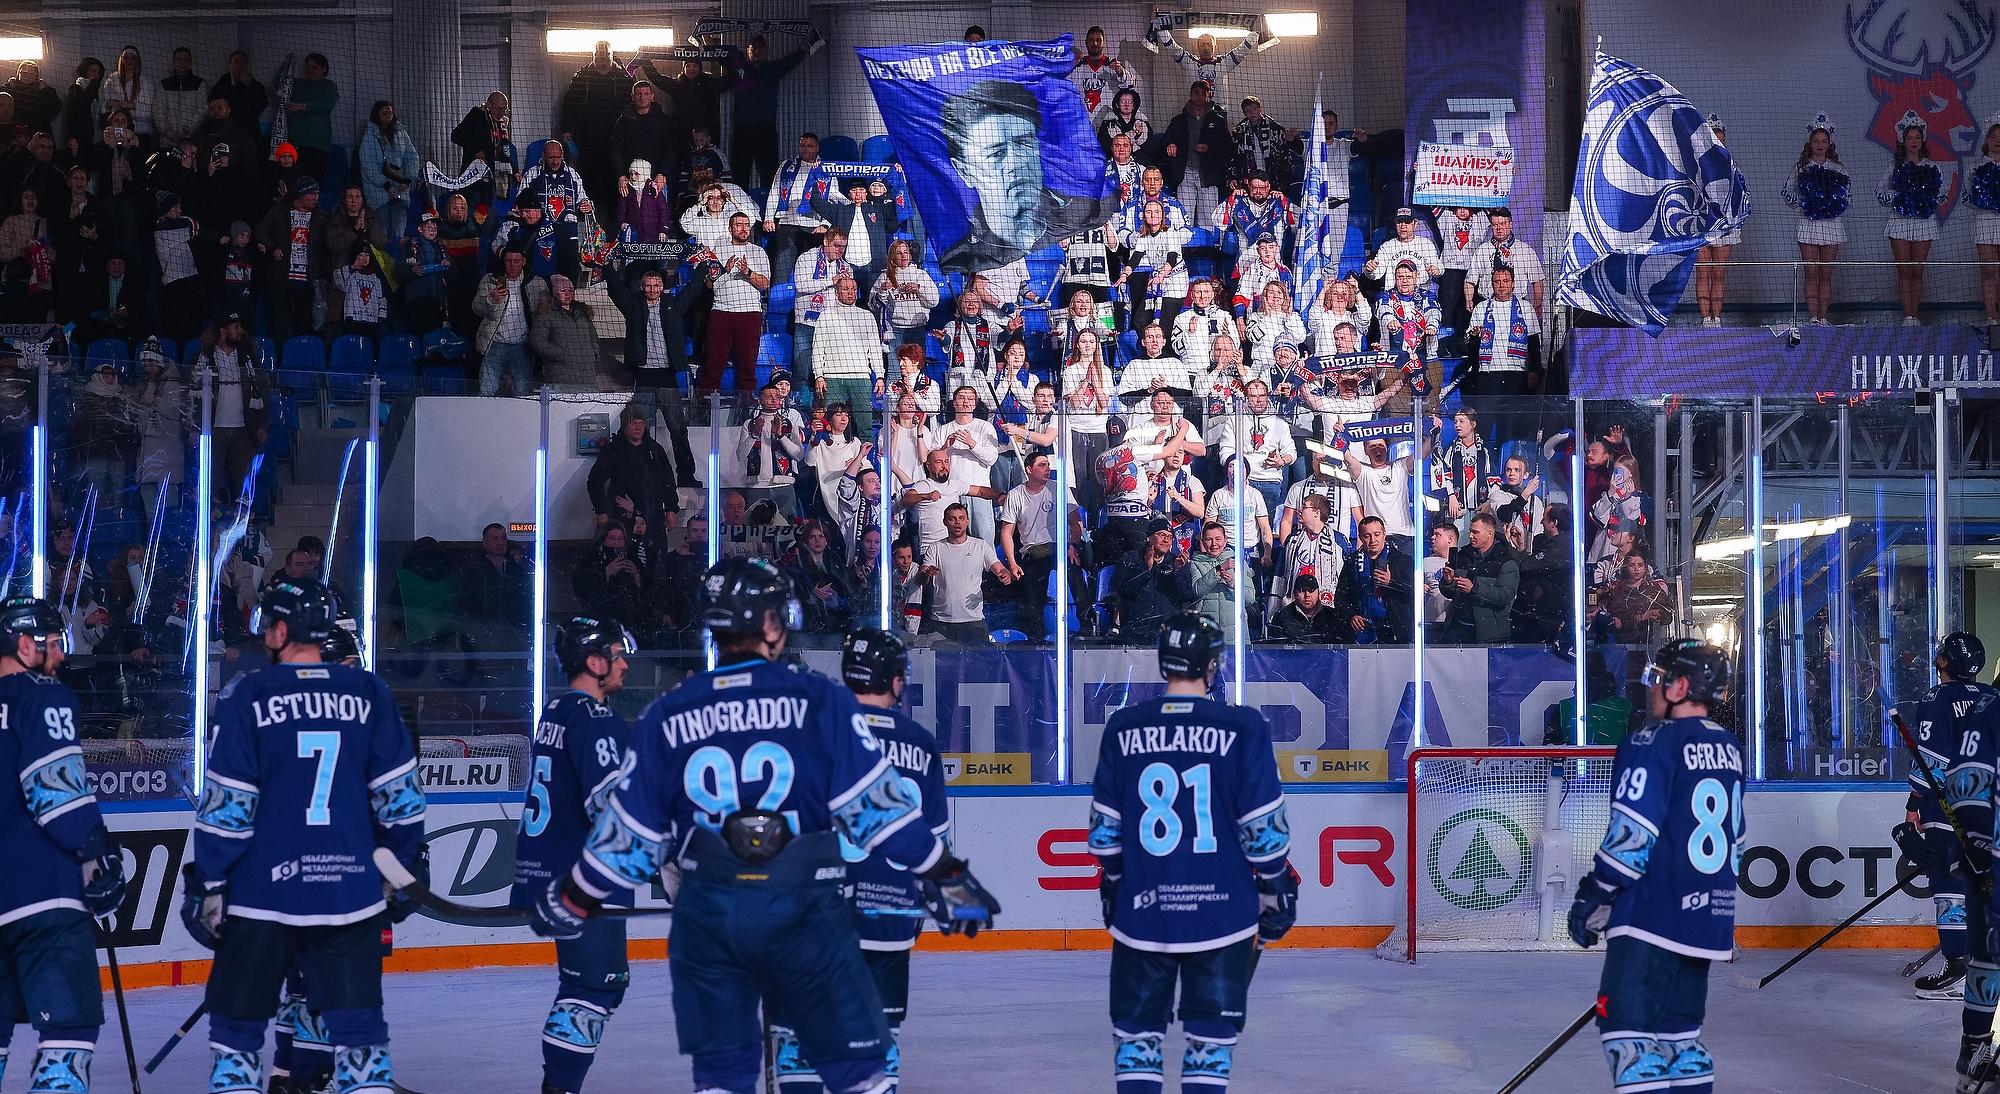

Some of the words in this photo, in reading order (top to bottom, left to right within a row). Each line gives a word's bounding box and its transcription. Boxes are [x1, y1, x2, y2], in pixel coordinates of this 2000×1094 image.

[937, 52, 965, 75] НА
[965, 46, 1001, 70] ВСЕ
[623, 243, 684, 255] ТОРПЕДО
[1851, 349, 1993, 389] НИЖНИЙ
[1348, 421, 1415, 439] Торпед
[44, 707, 76, 741] 93
[252, 692, 372, 728] LETUNOV
[662, 696, 808, 749] VINOGRADOV
[1117, 725, 1237, 757] VARLAKOV
[1960, 730, 1981, 757] 16
[297, 730, 341, 826] 7
[965, 761, 1014, 776] БАНК
[1321, 759, 1371, 773] БАНК
[1814, 753, 1888, 777] Haier
[683, 740, 800, 835] 92
[1615, 767, 1647, 801] 89
[1138, 762, 1217, 856] 81
